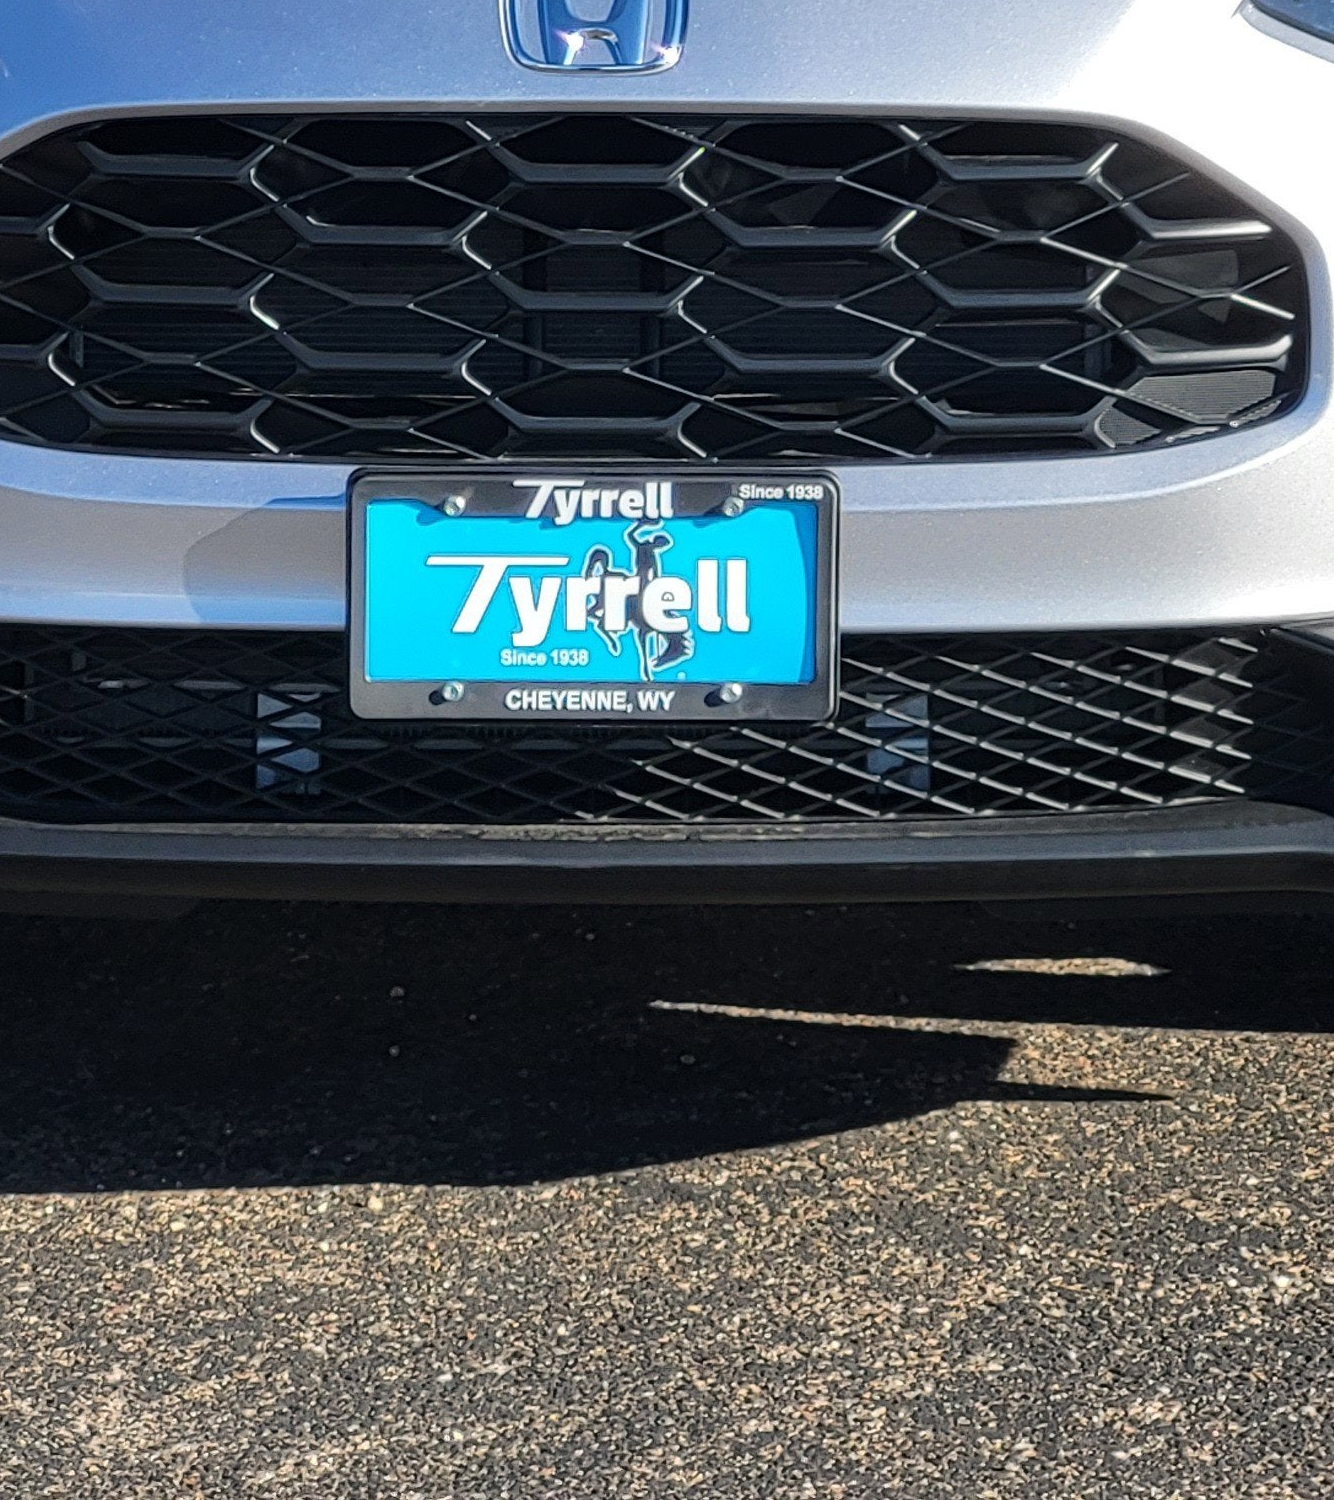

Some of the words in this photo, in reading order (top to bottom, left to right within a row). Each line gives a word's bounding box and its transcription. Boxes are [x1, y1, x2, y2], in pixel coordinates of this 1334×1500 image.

[512, 479, 674, 526] Tyrrell
[739, 483, 785, 499] Since
[786, 484, 824, 500] 1938
[425, 553, 751, 648] Tyrrell
[500, 648, 547, 667] Since
[550, 649, 589, 667] 1938
[505, 688, 633, 713] CHEYENNE,
[635, 689, 676, 711] WY
